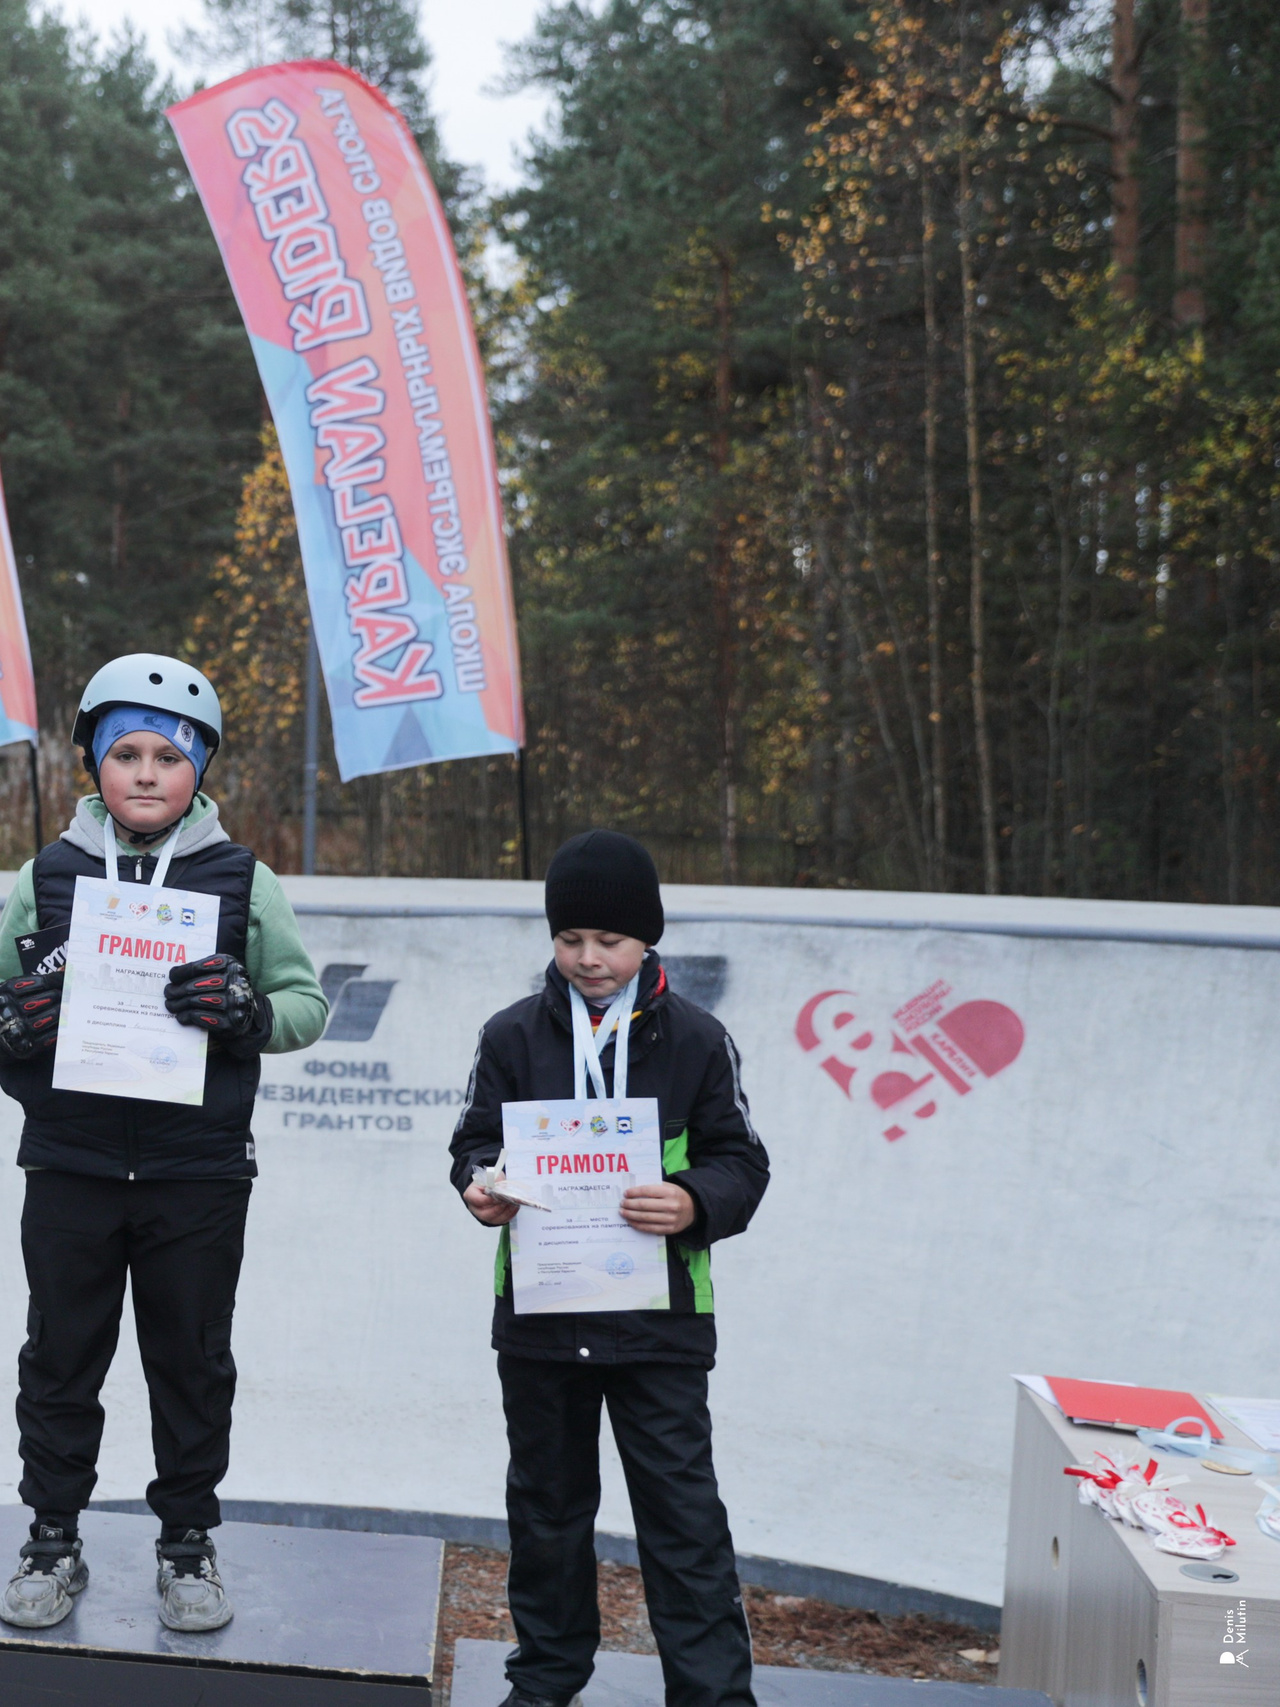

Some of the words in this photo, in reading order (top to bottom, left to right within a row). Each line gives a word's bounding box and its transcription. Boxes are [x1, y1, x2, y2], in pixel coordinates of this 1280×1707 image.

[98, 933, 187, 964] ГРАМОТА
[115, 967, 166, 979] НАГРАЖДАЕТСЯ
[303, 1059, 392, 1082] ФОНД
[283, 1111, 413, 1132] ГРАНТОВ
[536, 1153, 629, 1175] ГРАМОТА
[558, 1184, 610, 1192] НАГРАЖДАЕТСЯ
